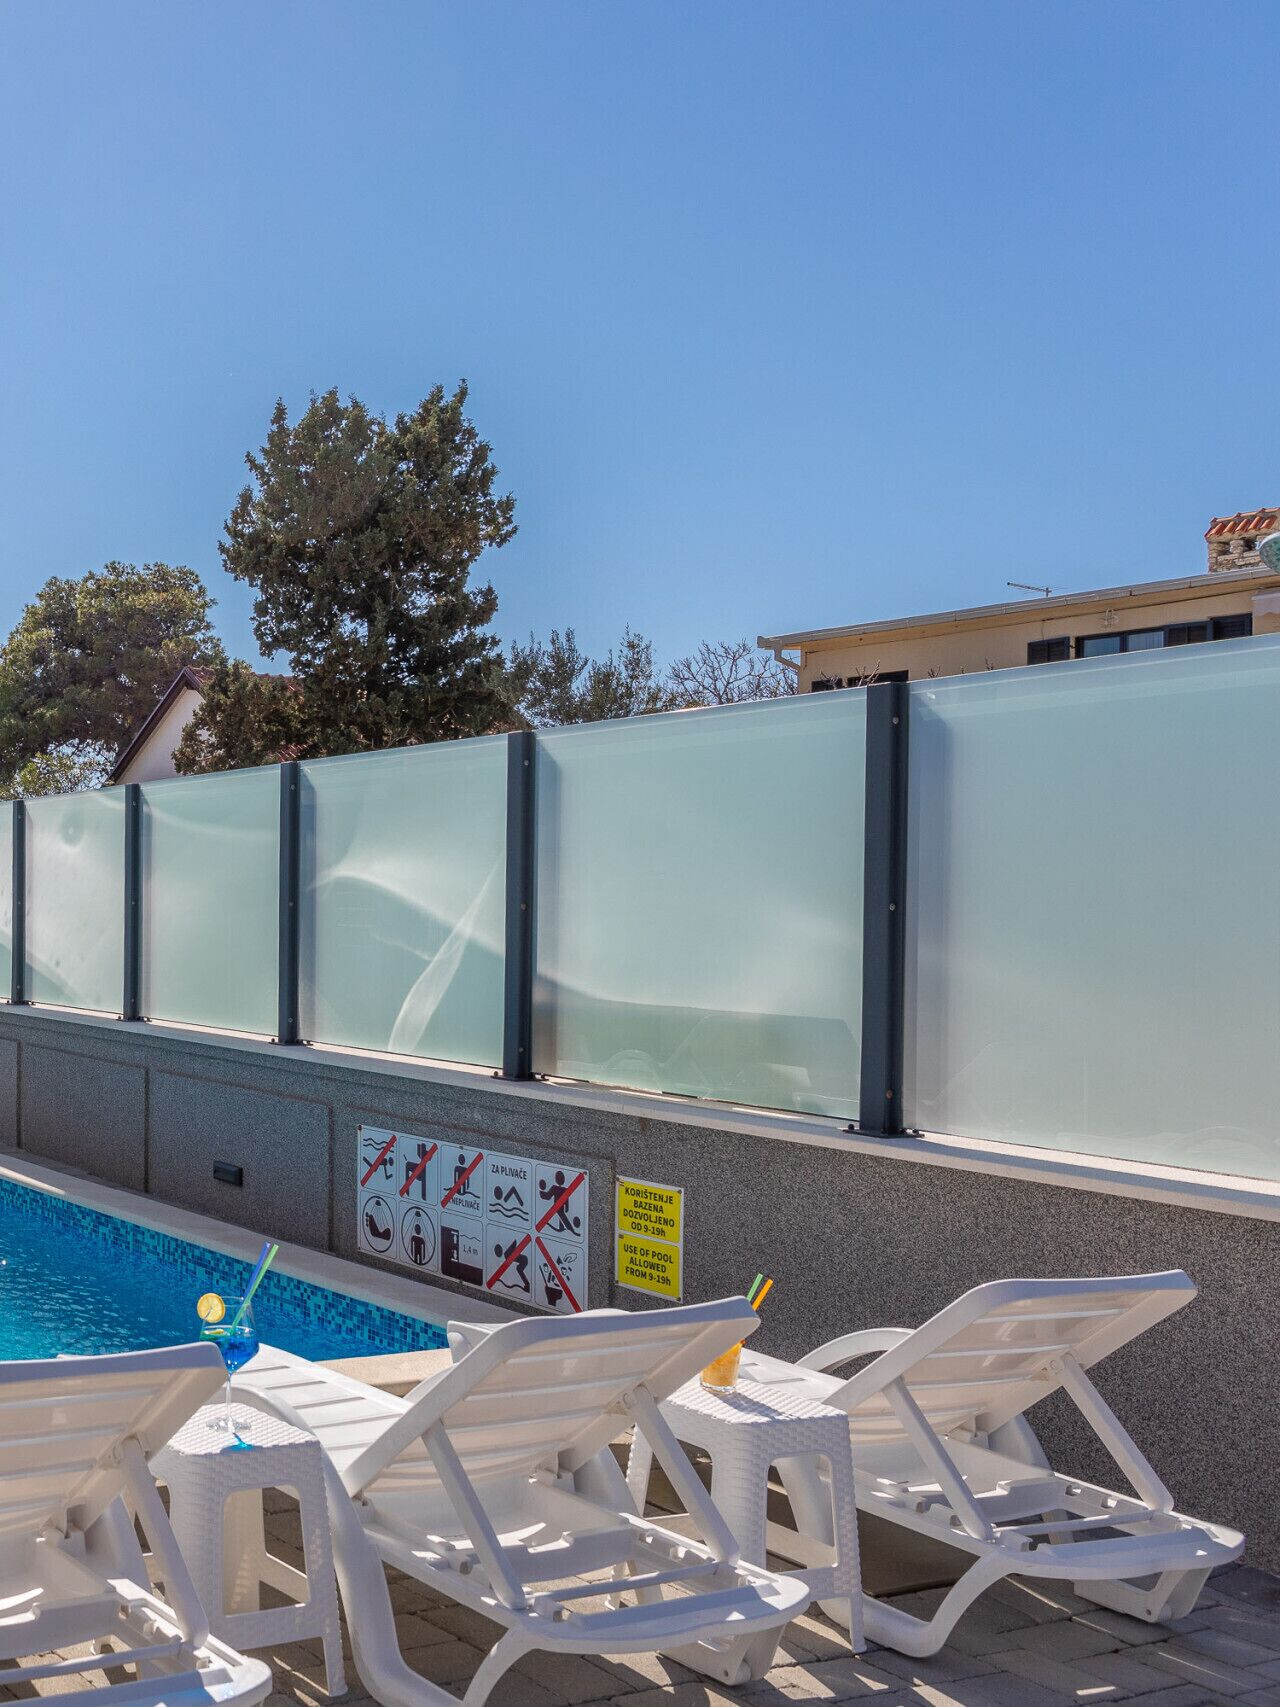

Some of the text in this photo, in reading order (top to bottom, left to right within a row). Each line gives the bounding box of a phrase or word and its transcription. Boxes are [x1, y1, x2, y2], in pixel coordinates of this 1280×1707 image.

[491, 1164, 527, 1180] ZA PLIVAČE
[452, 1197, 480, 1210] NEPLIVAČE
[624, 1186, 674, 1205] KORIŠTENJE
[633, 1199, 664, 1214] BAZENA
[623, 1208, 675, 1227] DOZVOLJENO
[631, 1221, 666, 1237] OD 9-19h
[623, 1243, 674, 1264] USE OF POOL
[629, 1256, 667, 1273] ALLOWED
[625, 1265, 671, 1286] FROM 9-19h
